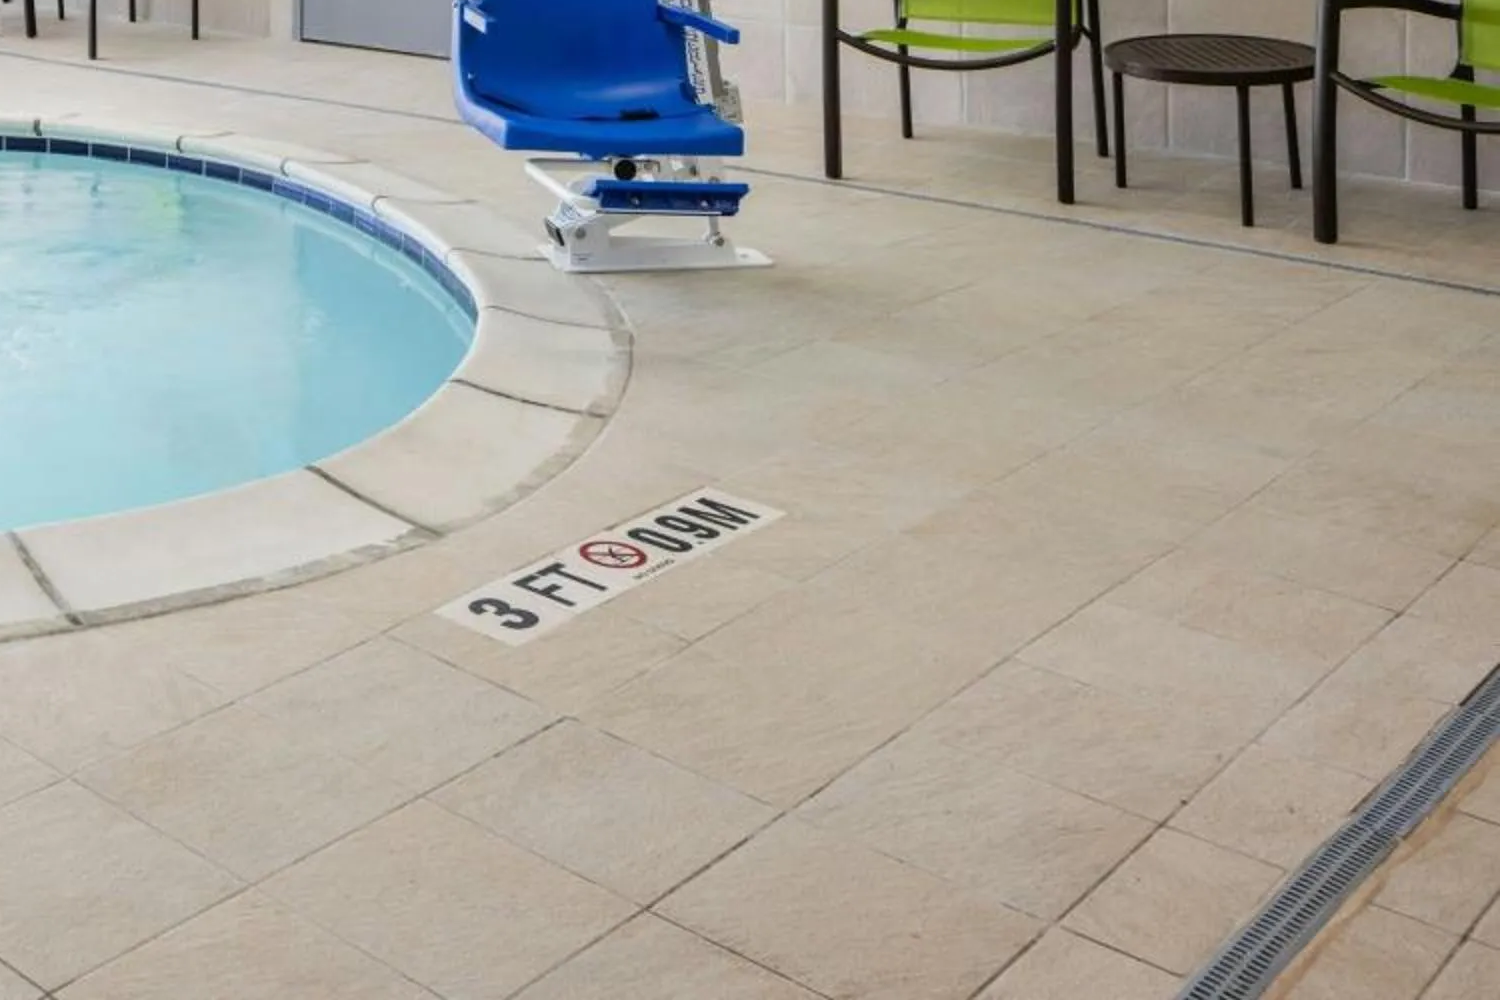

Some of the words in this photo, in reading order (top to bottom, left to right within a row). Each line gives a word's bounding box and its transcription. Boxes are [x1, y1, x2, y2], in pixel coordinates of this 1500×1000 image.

[467, 598, 540, 631] 3
[512, 562, 608, 608] FT
[627, 497, 760, 553] 0.9M
